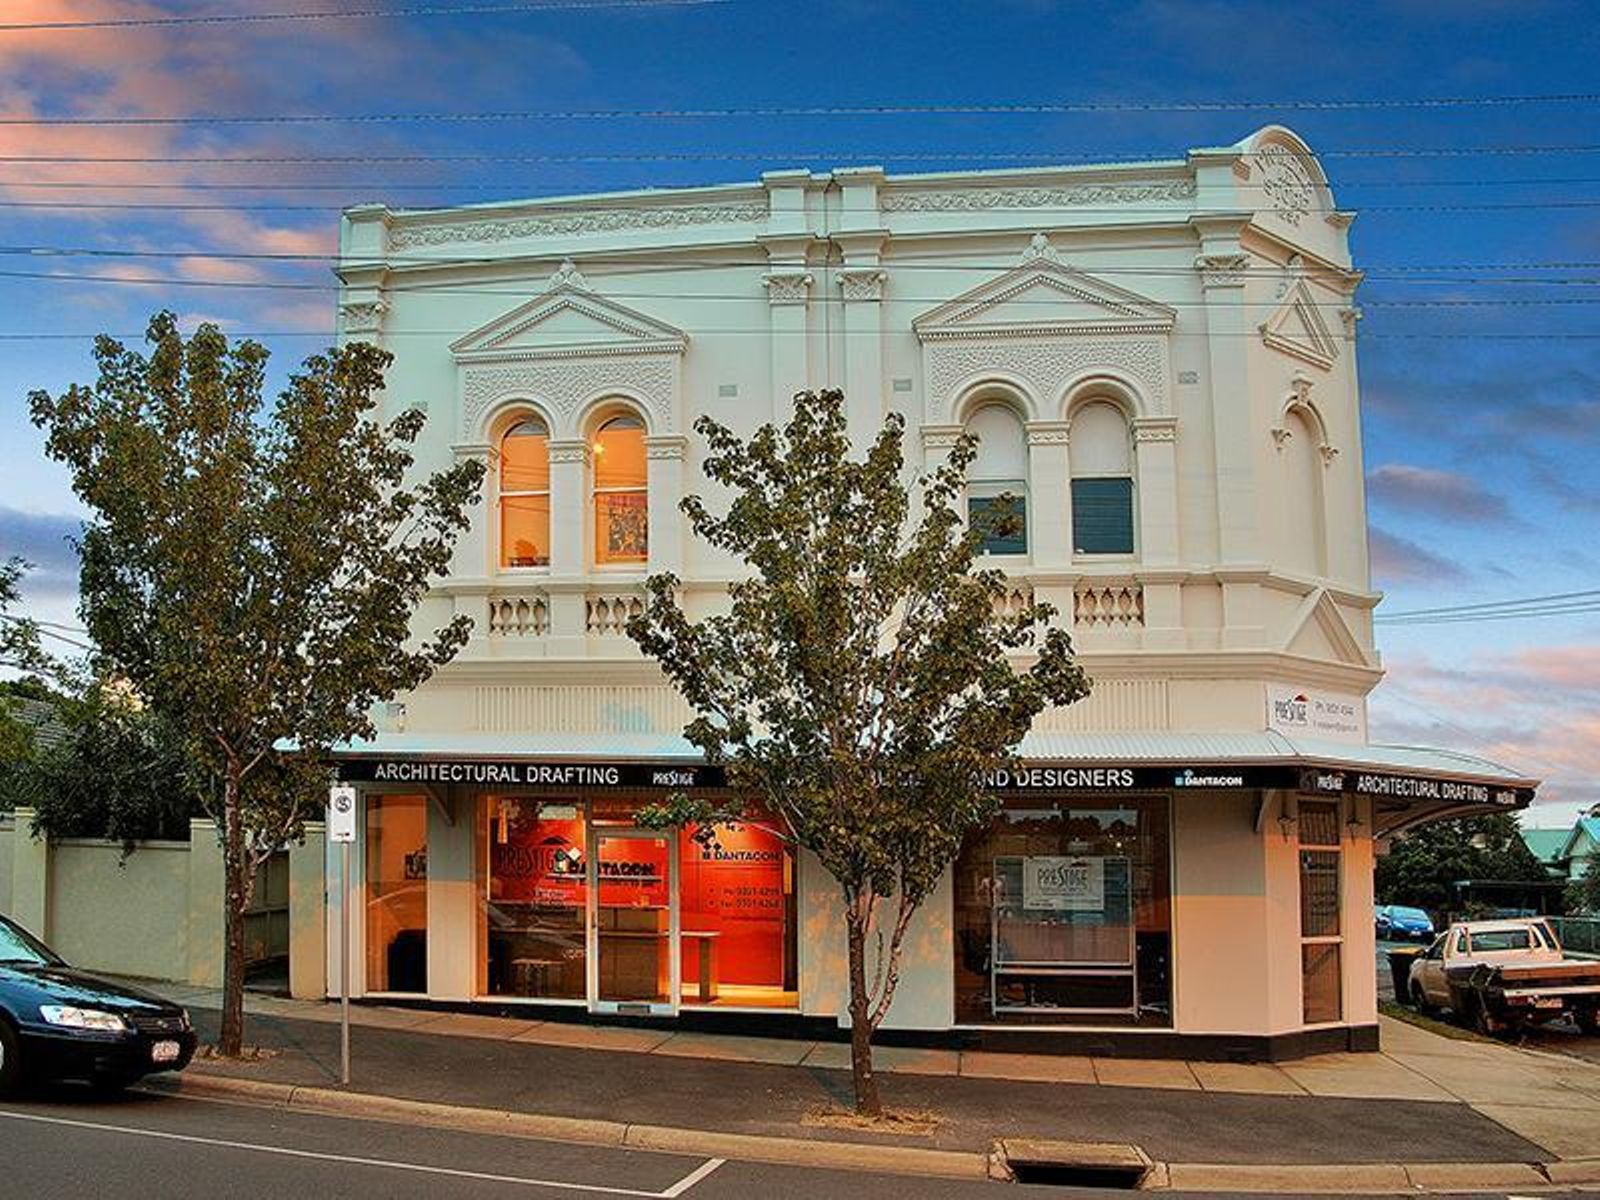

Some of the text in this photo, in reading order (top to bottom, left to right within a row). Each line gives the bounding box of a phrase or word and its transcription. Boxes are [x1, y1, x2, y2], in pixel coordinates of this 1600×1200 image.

[374, 763, 620, 785] ARCHITECTURAL DRAFTING
[652, 769, 695, 787] PRESTIGE
[1015, 769, 1135, 787] DESIGNERS
[1184, 776, 1243, 786] DANTACON
[1356, 775, 1489, 802] ARCHITECTURAL DRAFTING
[715, 851, 780, 861] DANTACON
